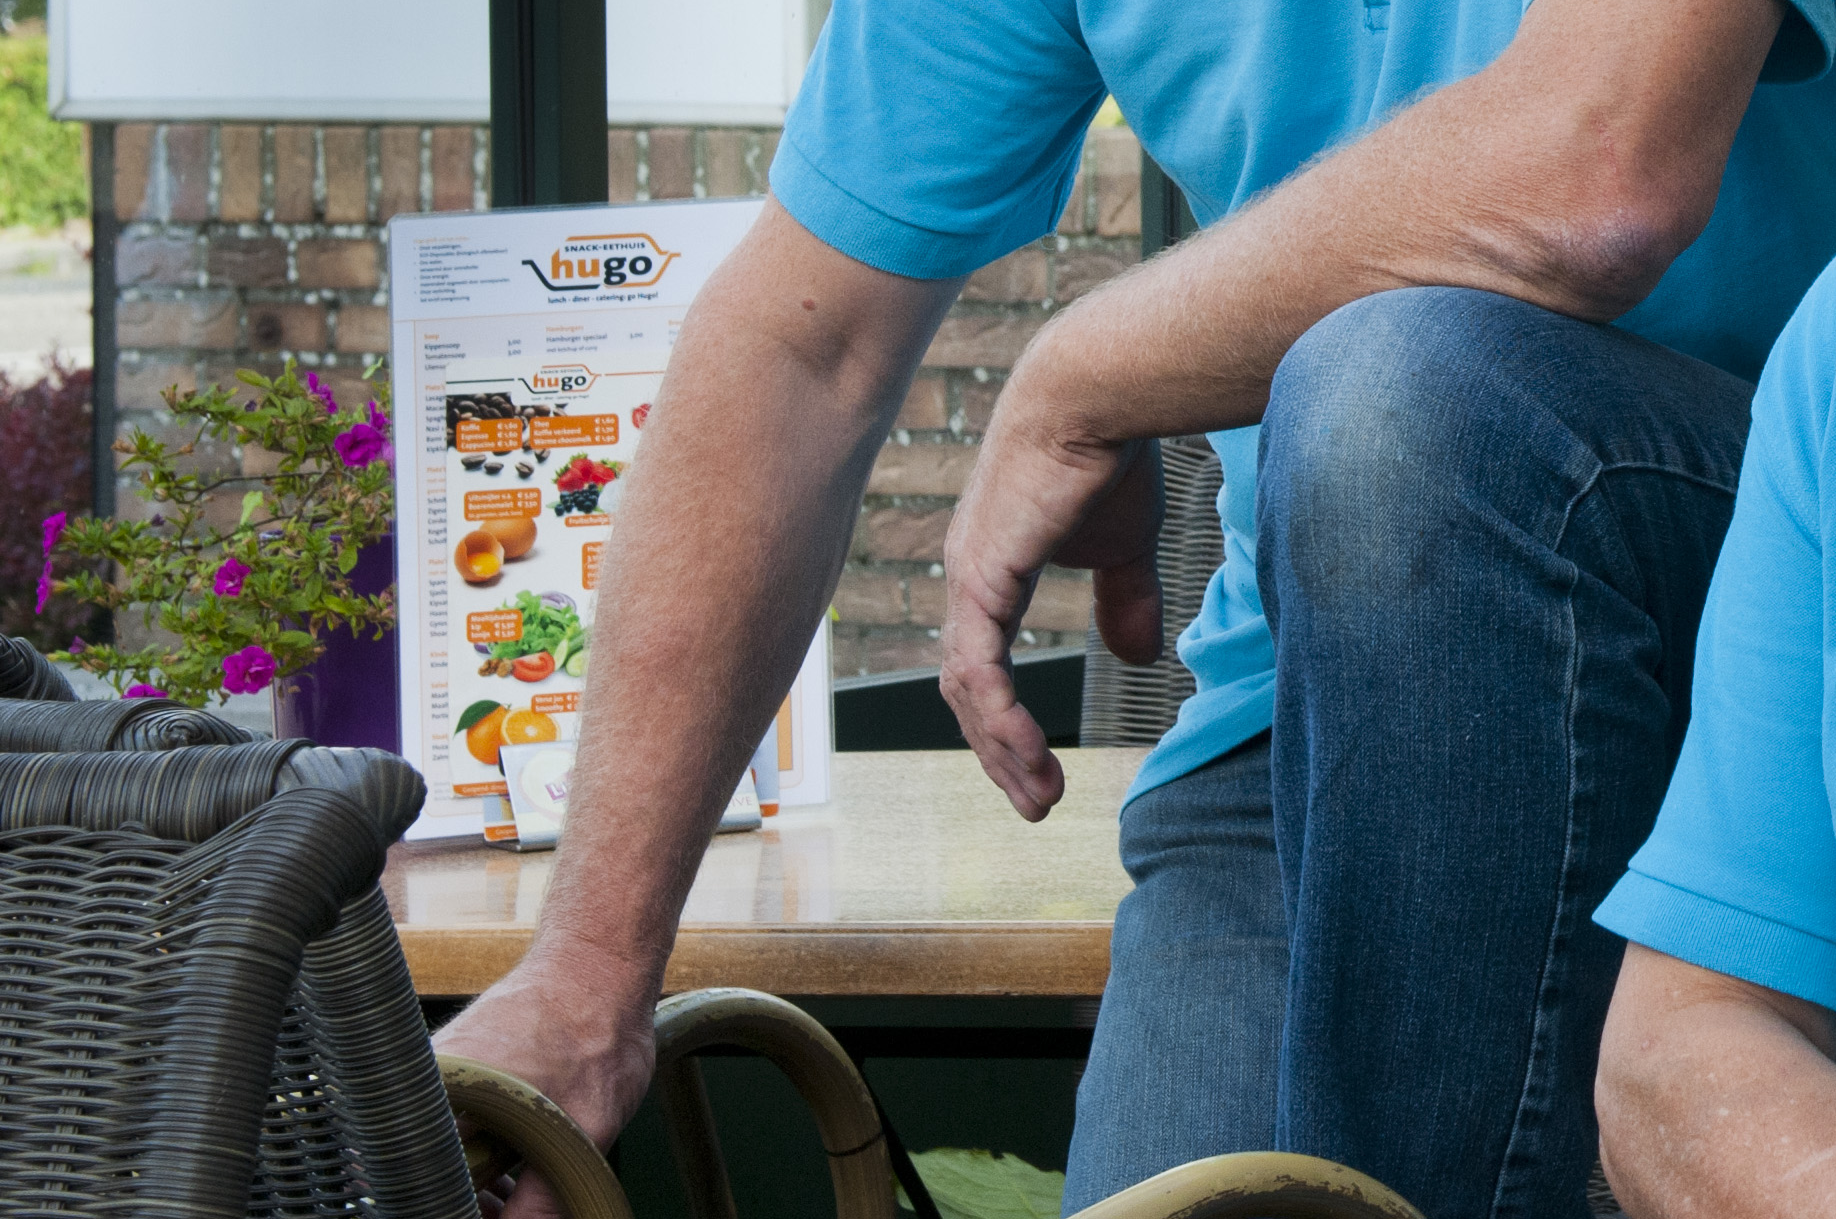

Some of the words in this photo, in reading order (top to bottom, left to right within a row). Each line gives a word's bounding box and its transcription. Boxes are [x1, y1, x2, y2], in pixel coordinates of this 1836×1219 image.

[551, 248, 653, 286] hugo
[533, 372, 587, 391] hugo
[461, 423, 480, 431] Koffie
